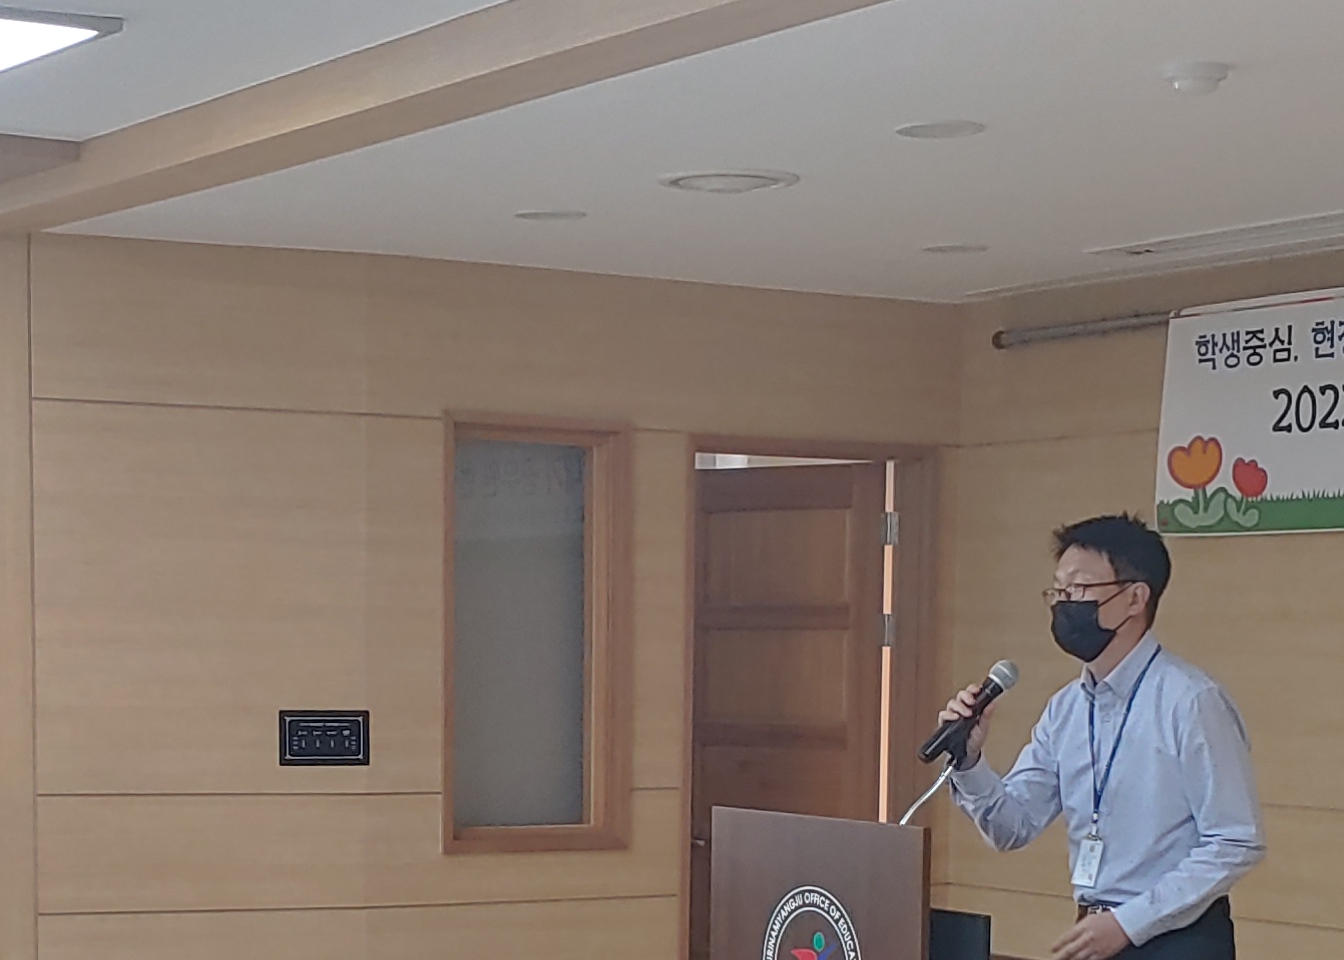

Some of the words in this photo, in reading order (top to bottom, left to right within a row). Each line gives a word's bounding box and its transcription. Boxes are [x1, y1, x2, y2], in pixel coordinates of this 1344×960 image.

[1195, 324, 1298, 370] 학생중심,
[804, 892, 830, 911] OFFICE
[829, 905, 841, 921] OF
